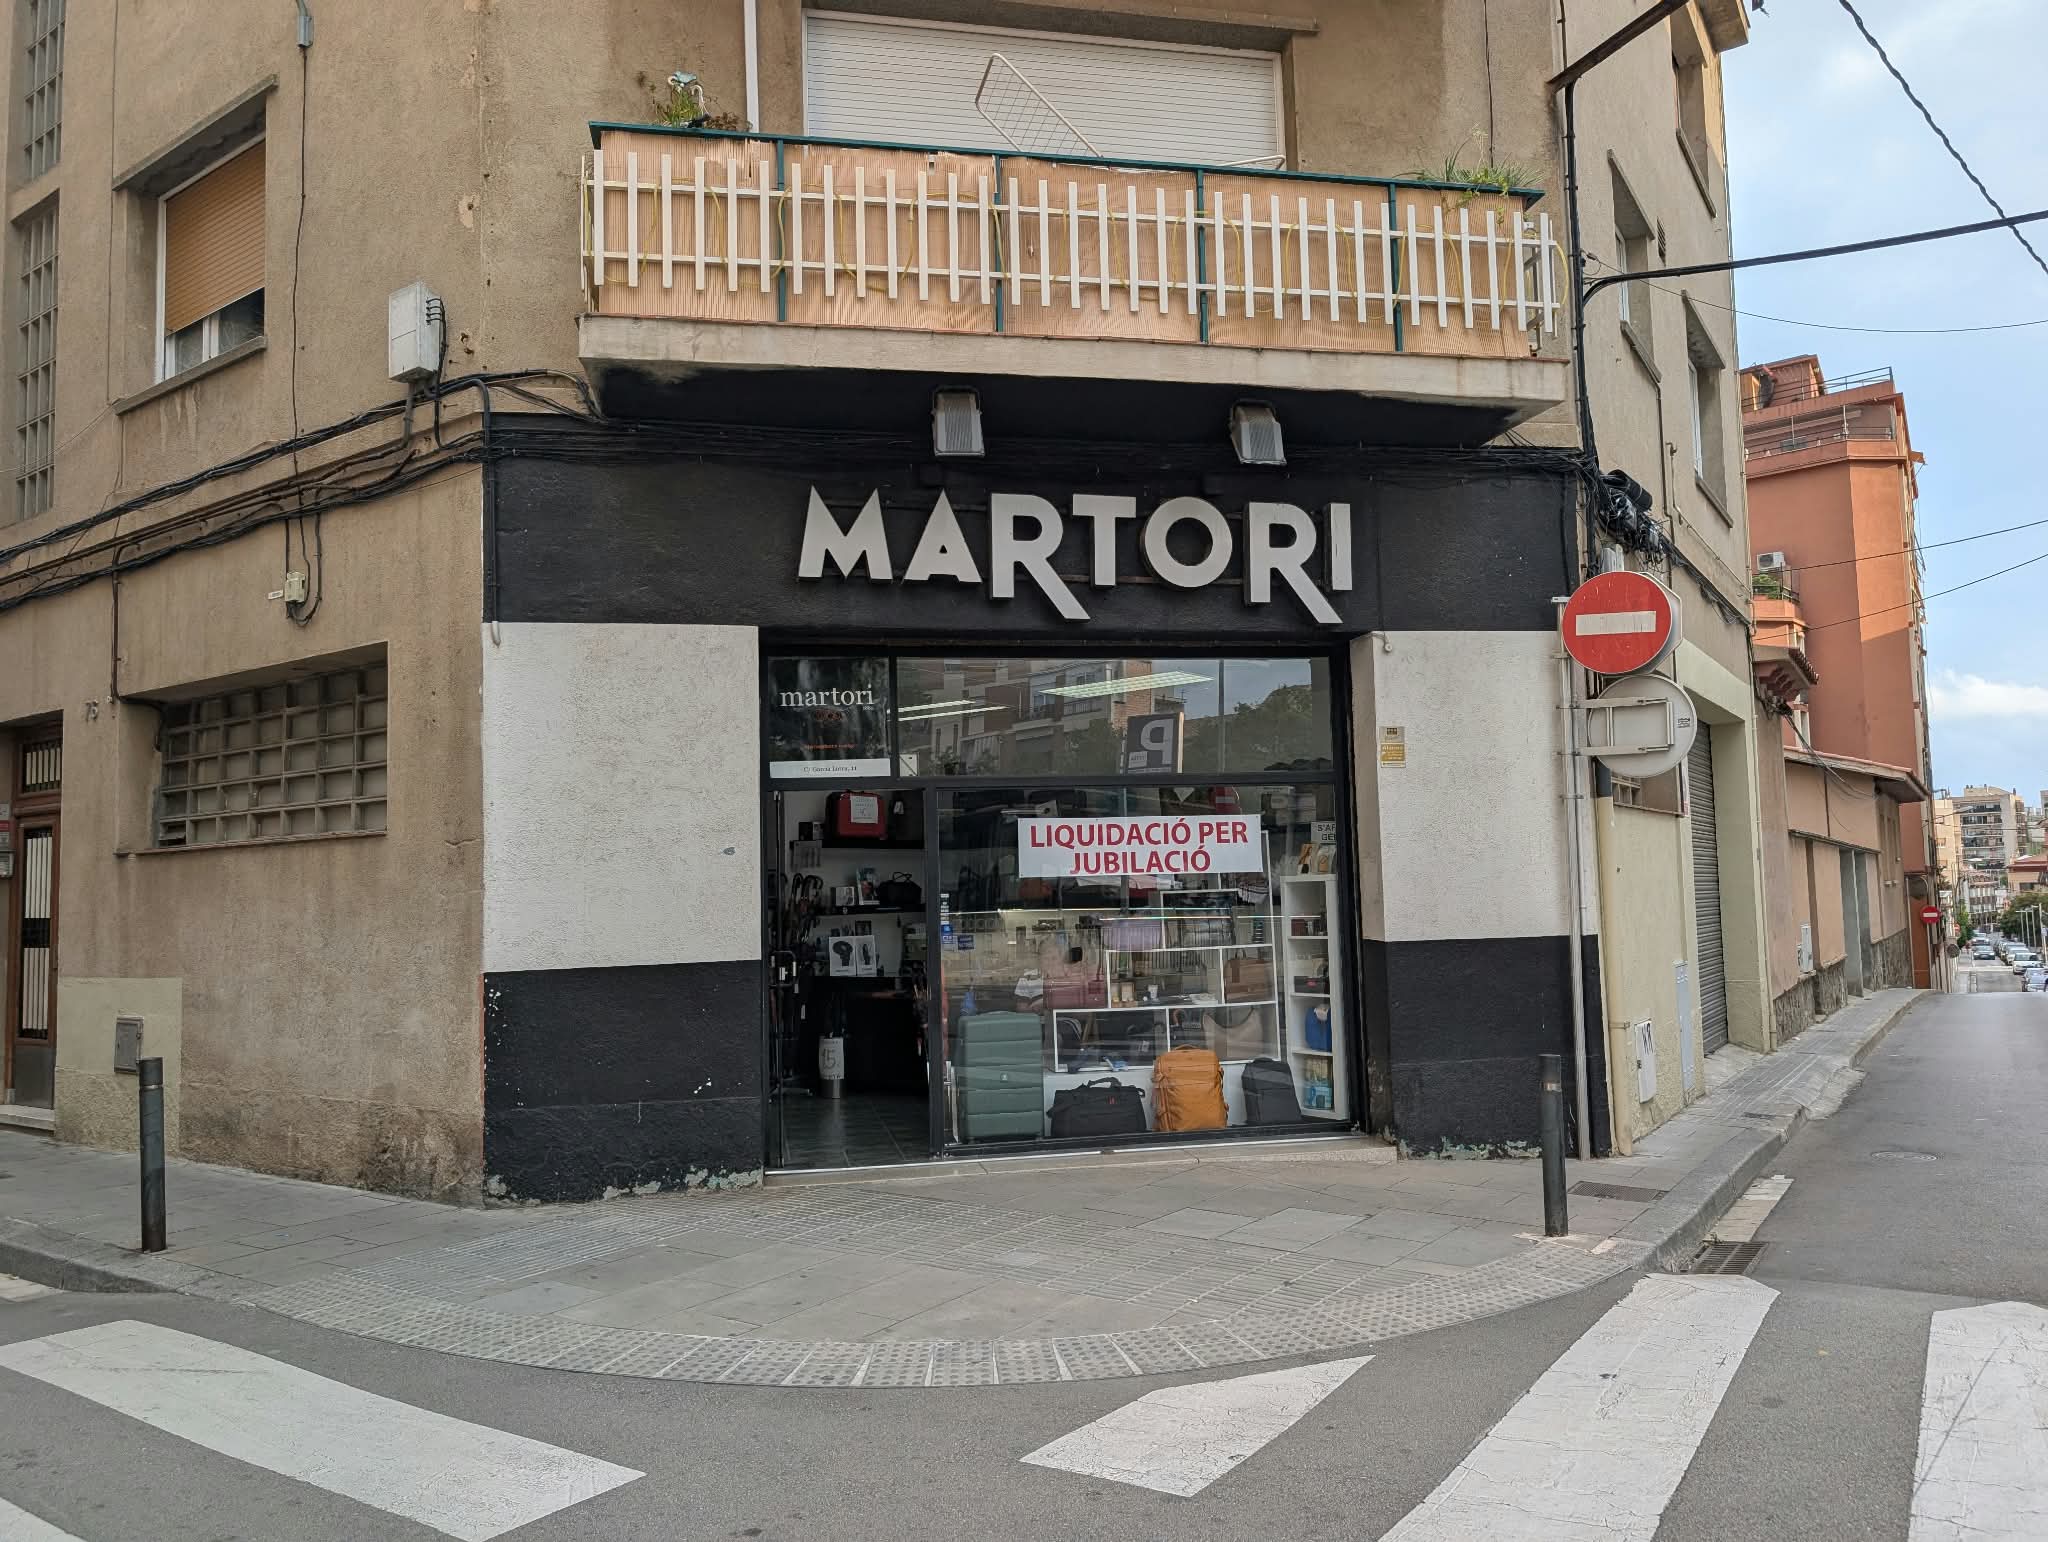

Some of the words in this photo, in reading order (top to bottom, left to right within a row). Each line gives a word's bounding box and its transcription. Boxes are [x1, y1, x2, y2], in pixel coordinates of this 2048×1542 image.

[797, 485, 1353, 624] MARTORI
[779, 683, 875, 707] martori
[1030, 818, 1191, 849] LIQUIDACIÓ
[1199, 821, 1248, 845] PER
[1070, 845, 1211, 875] JUBILACIÓ
